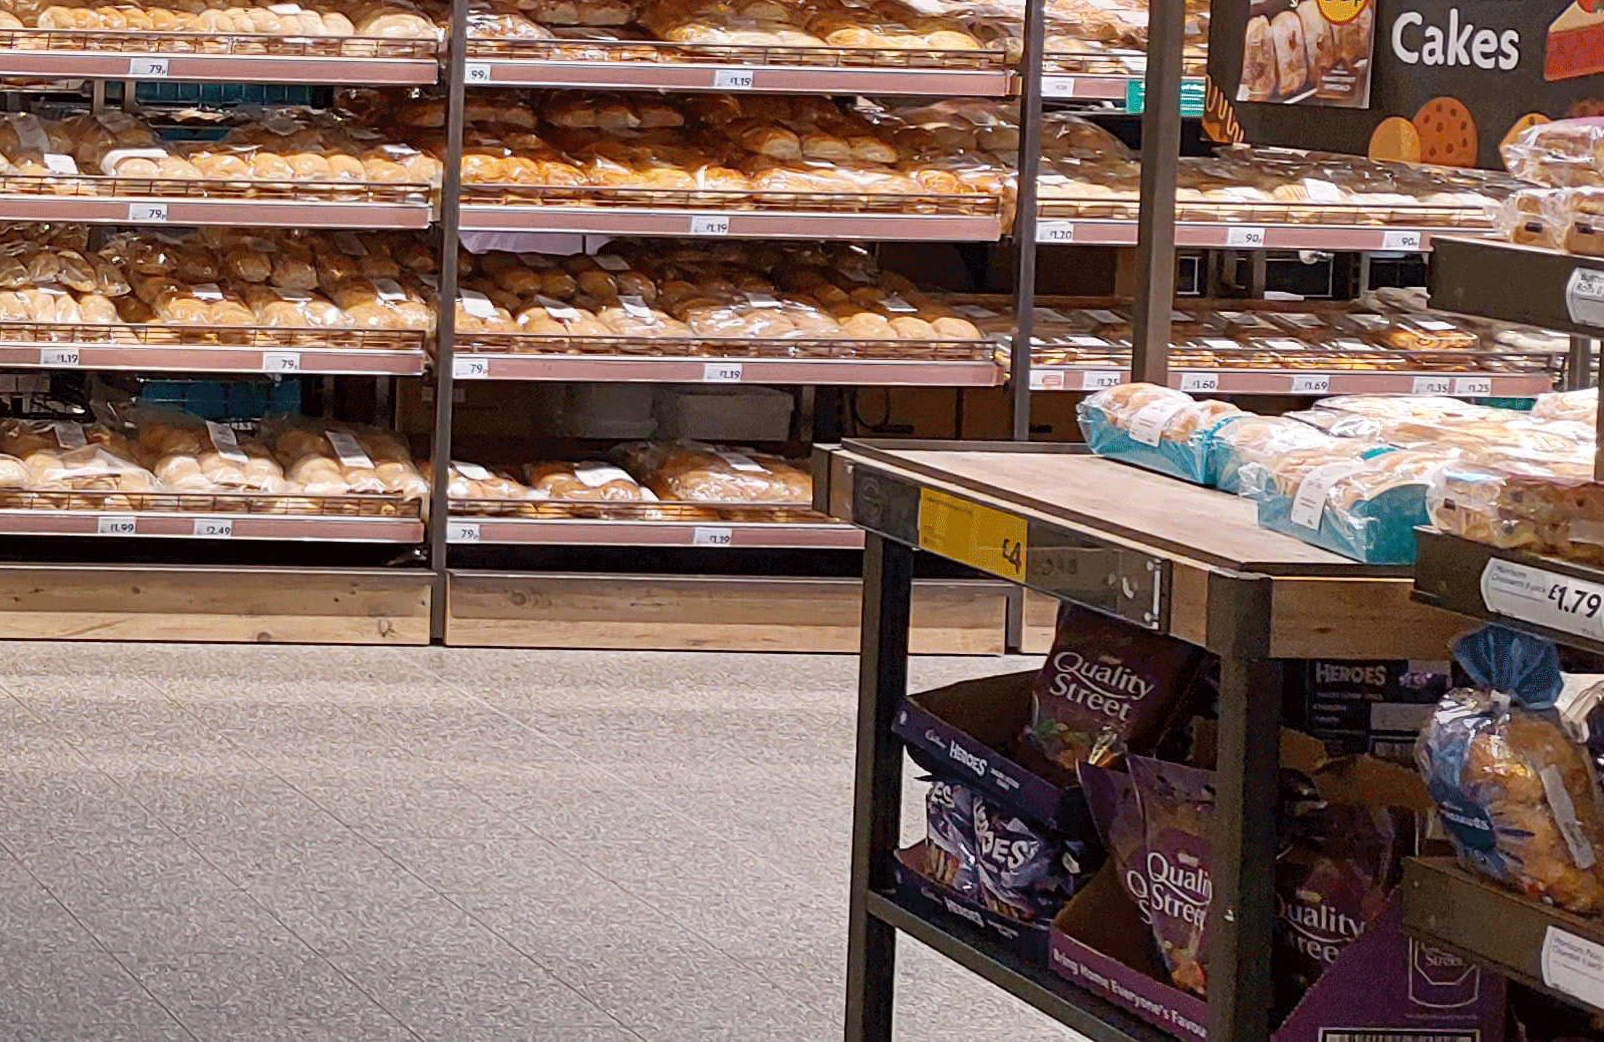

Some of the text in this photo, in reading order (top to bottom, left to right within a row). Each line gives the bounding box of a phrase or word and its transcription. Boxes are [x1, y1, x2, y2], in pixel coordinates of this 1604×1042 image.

[1392, 8, 1521, 70] Cakes
[150, 65, 166, 74] 79p
[149, 210, 166, 219] 79p
[1547, 583, 1602, 618] £1.79
[1054, 651, 1155, 701] Quality
[1315, 661, 1388, 686] HEROES
[1049, 673, 1133, 722] Street
[949, 740, 988, 777] HEROES
